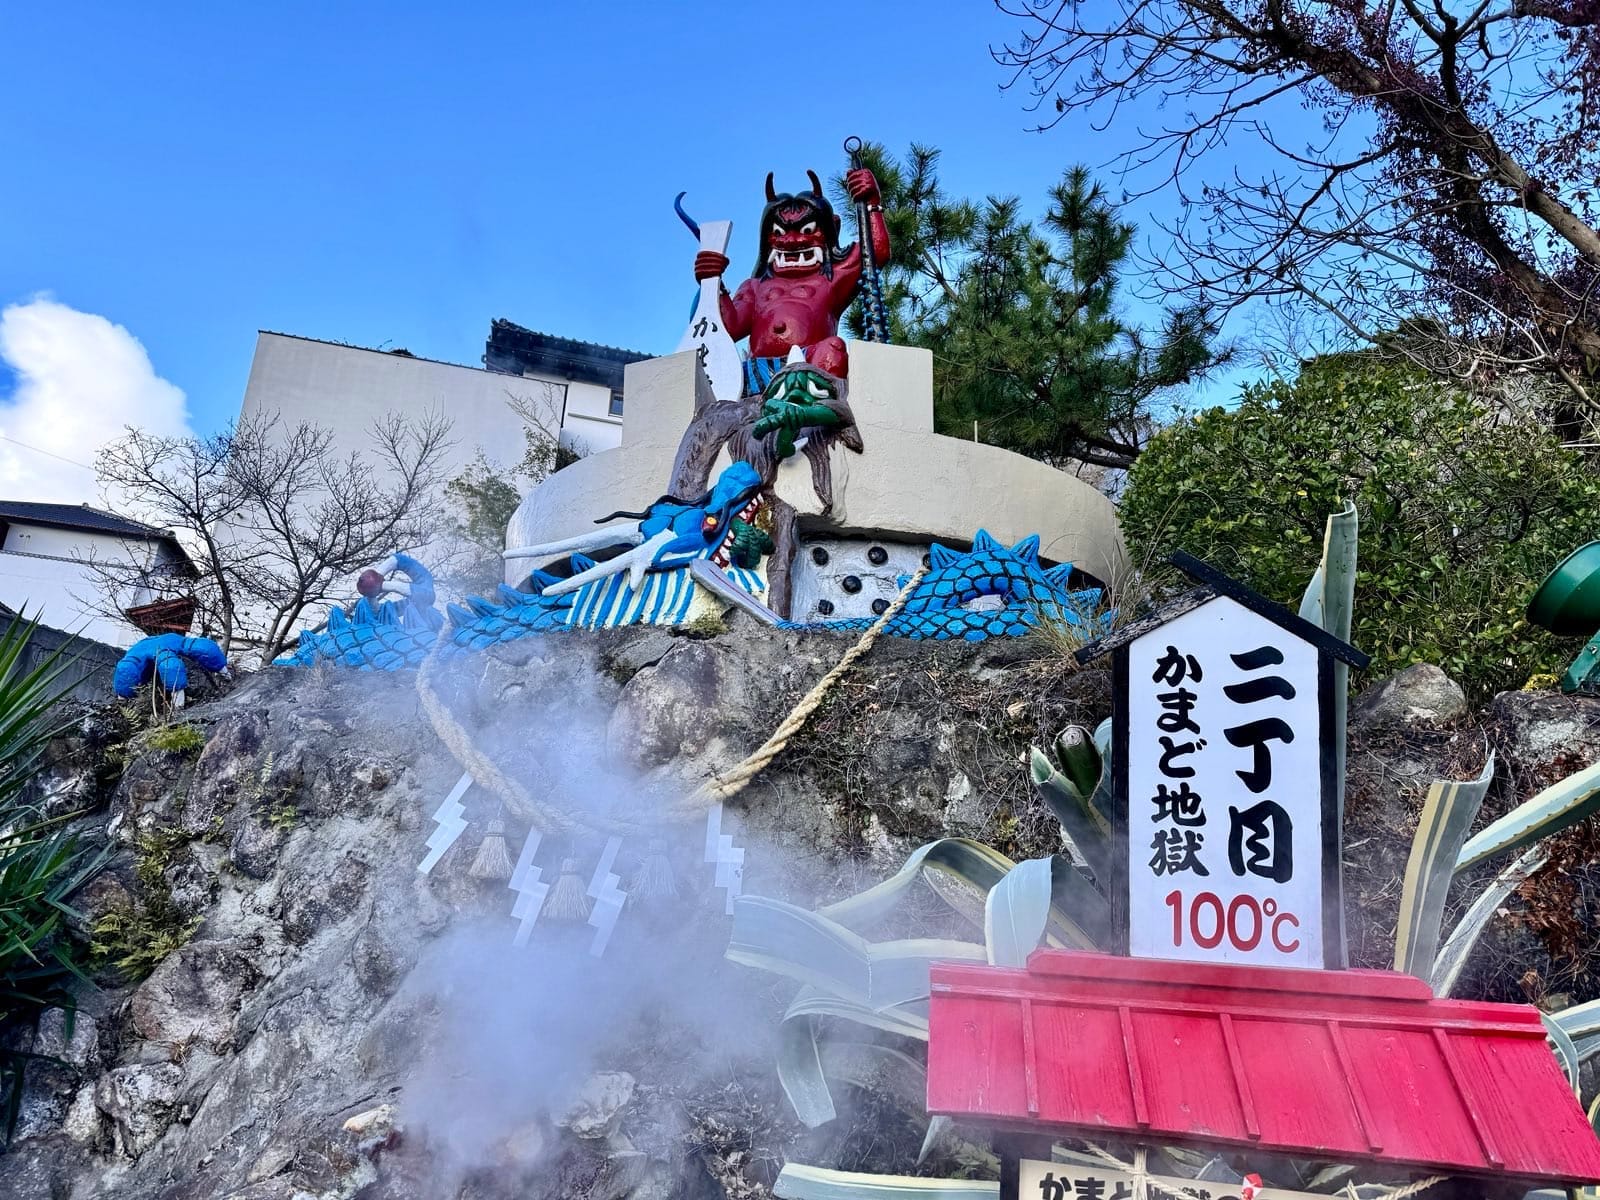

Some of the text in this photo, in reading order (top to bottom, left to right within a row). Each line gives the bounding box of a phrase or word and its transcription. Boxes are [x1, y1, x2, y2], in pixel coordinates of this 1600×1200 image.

[1148, 645, 1210, 877] かまど地獄
[1222, 645, 1297, 884] 二丁目
[1165, 890, 1300, 953] 100°C
